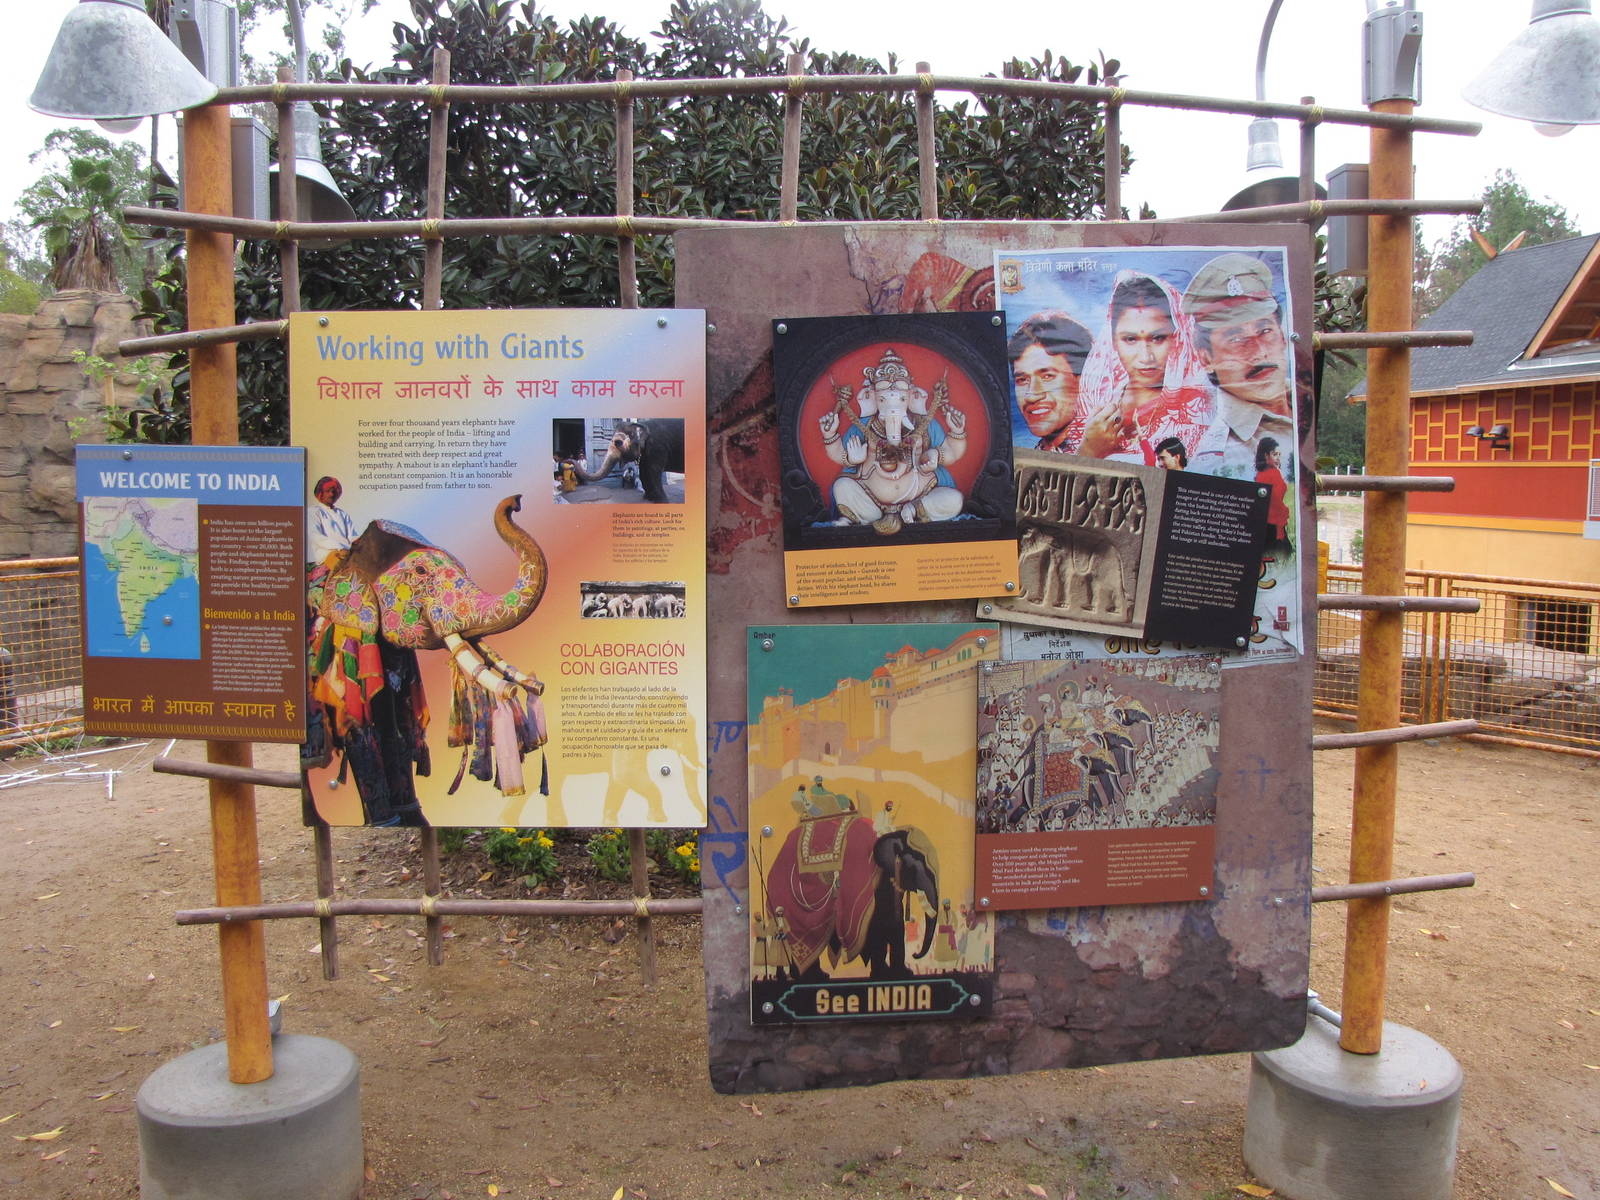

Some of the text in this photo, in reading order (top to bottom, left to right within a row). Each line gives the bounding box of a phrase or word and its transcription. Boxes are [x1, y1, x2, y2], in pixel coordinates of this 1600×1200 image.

[316, 333, 584, 365] Working with Giants
[316, 374, 684, 399] विशाल जानवरों के साथ काम करना
[358, 419, 370, 427] For
[462, 418, 496, 427] elephants
[498, 418, 515, 426] have
[411, 429, 435, 438] people
[473, 429, 495, 438] lifting
[496, 428, 511, 436] and
[358, 440, 388, 449] building
[404, 441, 436, 449] carrying.
[472, 439, 488, 448] they
[490, 439, 507, 447] have
[377, 450, 402, 458] treated
[422, 450, 440, 459] deep
[441, 451, 467, 459] respect
[451, 460, 488, 470] elephant's
[406, 472, 448, 480] companion.
[476, 470, 513, 478] honorable
[99, 471, 280, 491] WELCOME TO INDIA
[359, 483, 398, 491] occupation
[399, 482, 423, 491] passed
[204, 607, 296, 621] Bienvenido a la India
[560, 640, 685, 657] COLABORACIÓN
[560, 661, 678, 675] CON GIGANTES
[648, 694, 688, 702] construyendo
[93, 695, 296, 722] भारत में आपका स्वागत है
[574, 735, 608, 743] compañero
[816, 985, 931, 1015] See INDIA
